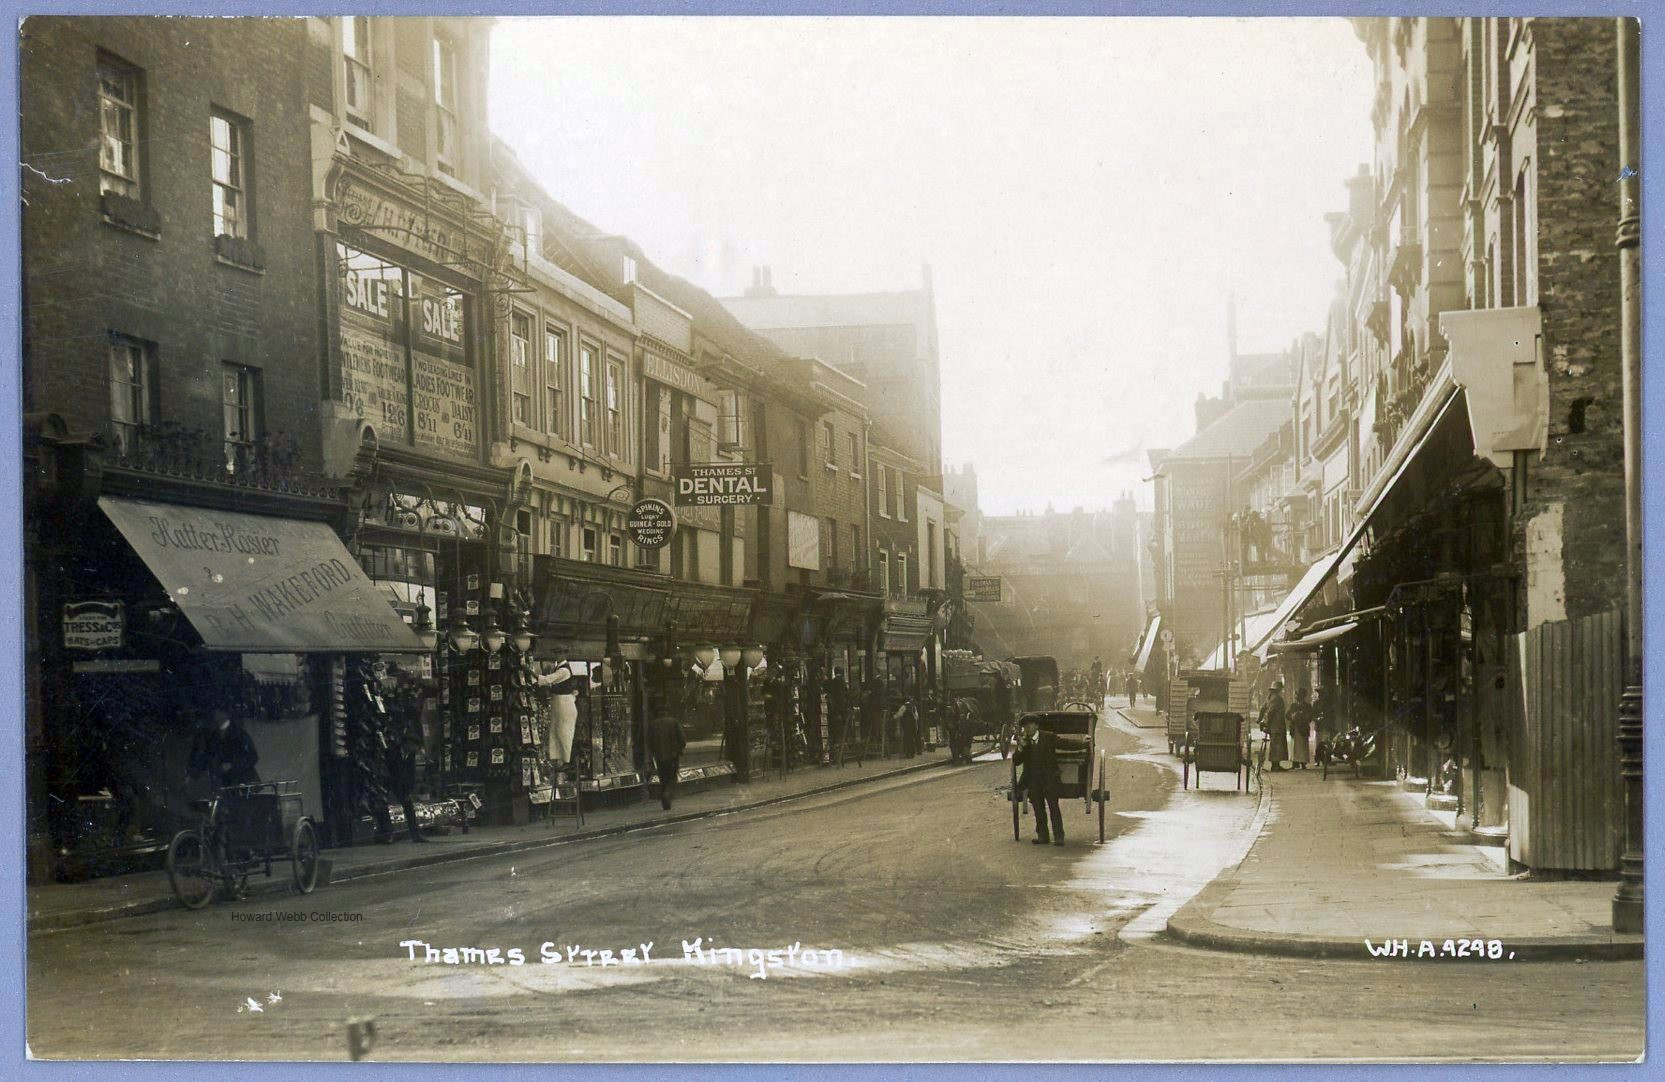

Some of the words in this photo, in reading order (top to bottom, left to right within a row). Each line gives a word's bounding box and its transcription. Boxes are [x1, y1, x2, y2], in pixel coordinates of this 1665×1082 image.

[347, 271, 389, 318] SALE
[423, 299, 460, 342] SALE
[372, 357, 406, 385] FOOTWEAR
[646, 353, 700, 393] ELLISDON
[413, 373, 436, 393] LADIES
[436, 377, 474, 404] FOOTWEAR
[692, 467, 742, 477] THAMES
[679, 476, 767, 495] DENTAL
[635, 503, 665, 516] SPIKINS
[697, 494, 753, 505] SURGERY
[629, 520, 652, 528] GUINEA
[656, 520, 672, 528] GOLD
[215, 522, 280, 556] Hosier
[637, 534, 664, 545] RINGS
